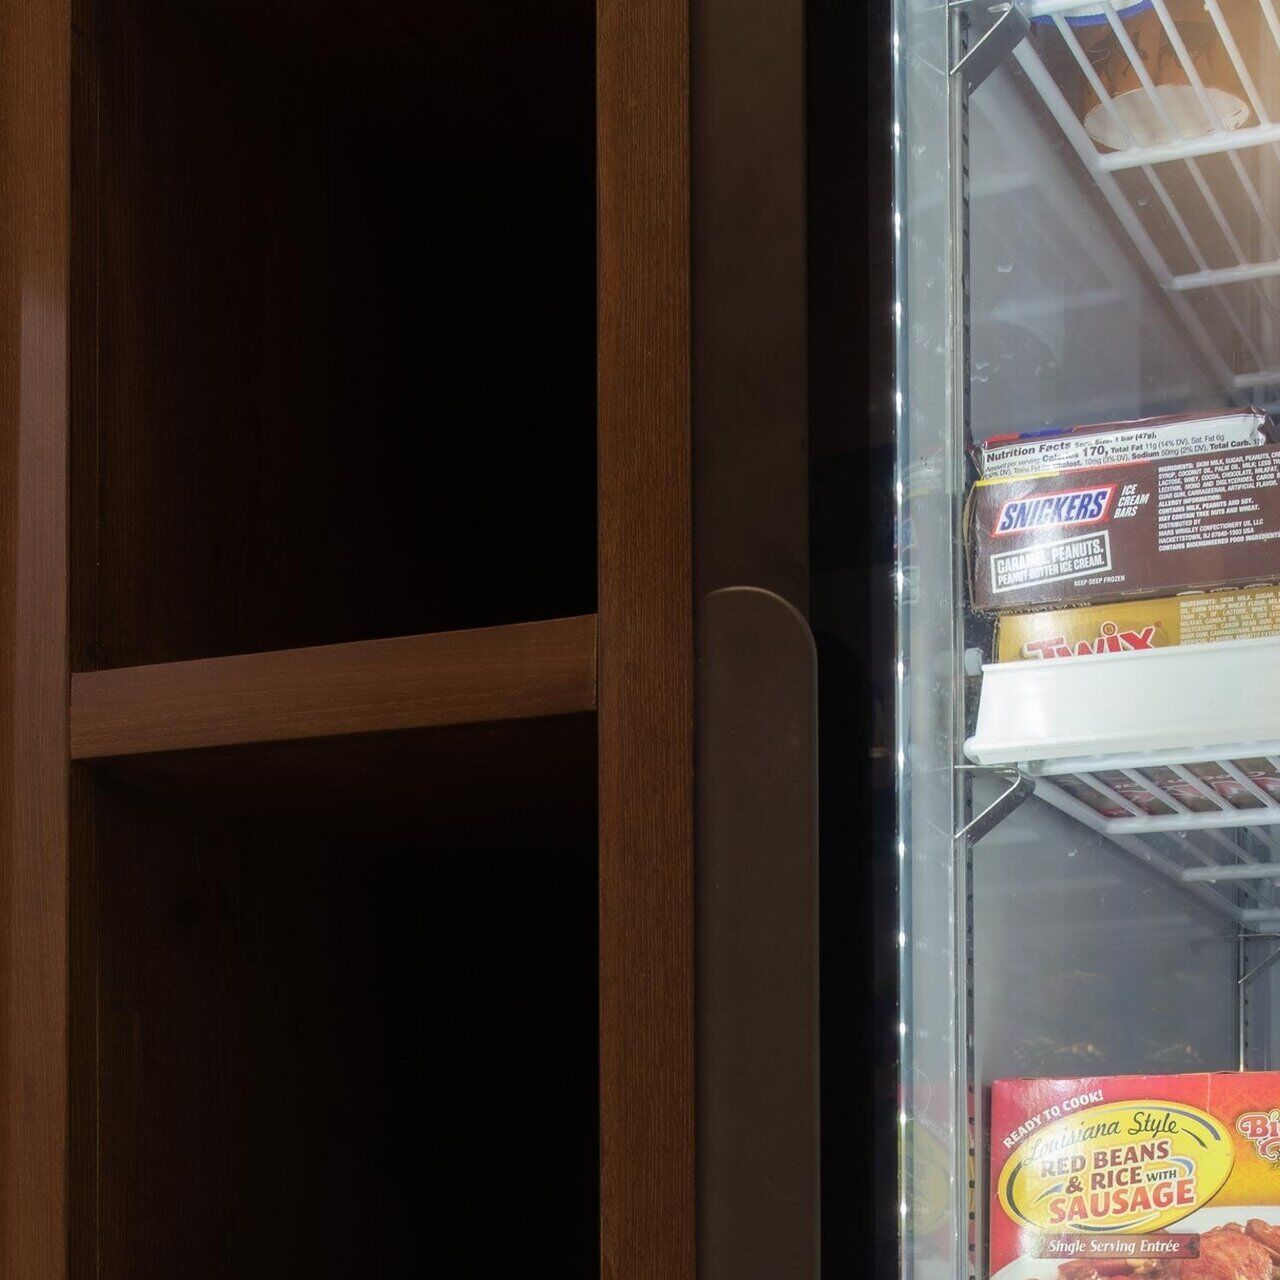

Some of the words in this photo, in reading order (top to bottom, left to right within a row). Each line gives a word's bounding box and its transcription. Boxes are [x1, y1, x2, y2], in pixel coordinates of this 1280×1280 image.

[987, 445, 1035, 463] Nutrition
[1039, 442, 1071, 452] Facts
[1117, 493, 1150, 507] CREAM
[1121, 484, 1138, 496] ICE
[1000, 490, 1108, 531] SNICKERS
[1114, 506, 1138, 519] BARS
[1002, 1119, 1041, 1150] READY
[1043, 1106, 1062, 1121] TO
[1062, 1090, 1104, 1110] COOK!
[1022, 1119, 1121, 1166] Louisiana
[1128, 1111, 1180, 1138] Style
[1041, 1154, 1087, 1177] RED
[1093, 1140, 1171, 1170] BEANS
[1065, 1176, 1083, 1195] &
[1090, 1166, 1142, 1190] RICE
[1146, 1170, 1177, 1182] WITH
[1048, 1178, 1195, 1225] SAUSAGE
[1049, 1239, 1087, 1255] Single
[1090, 1240, 1136, 1255] Serving
[1140, 1239, 1180, 1251] Entrée
